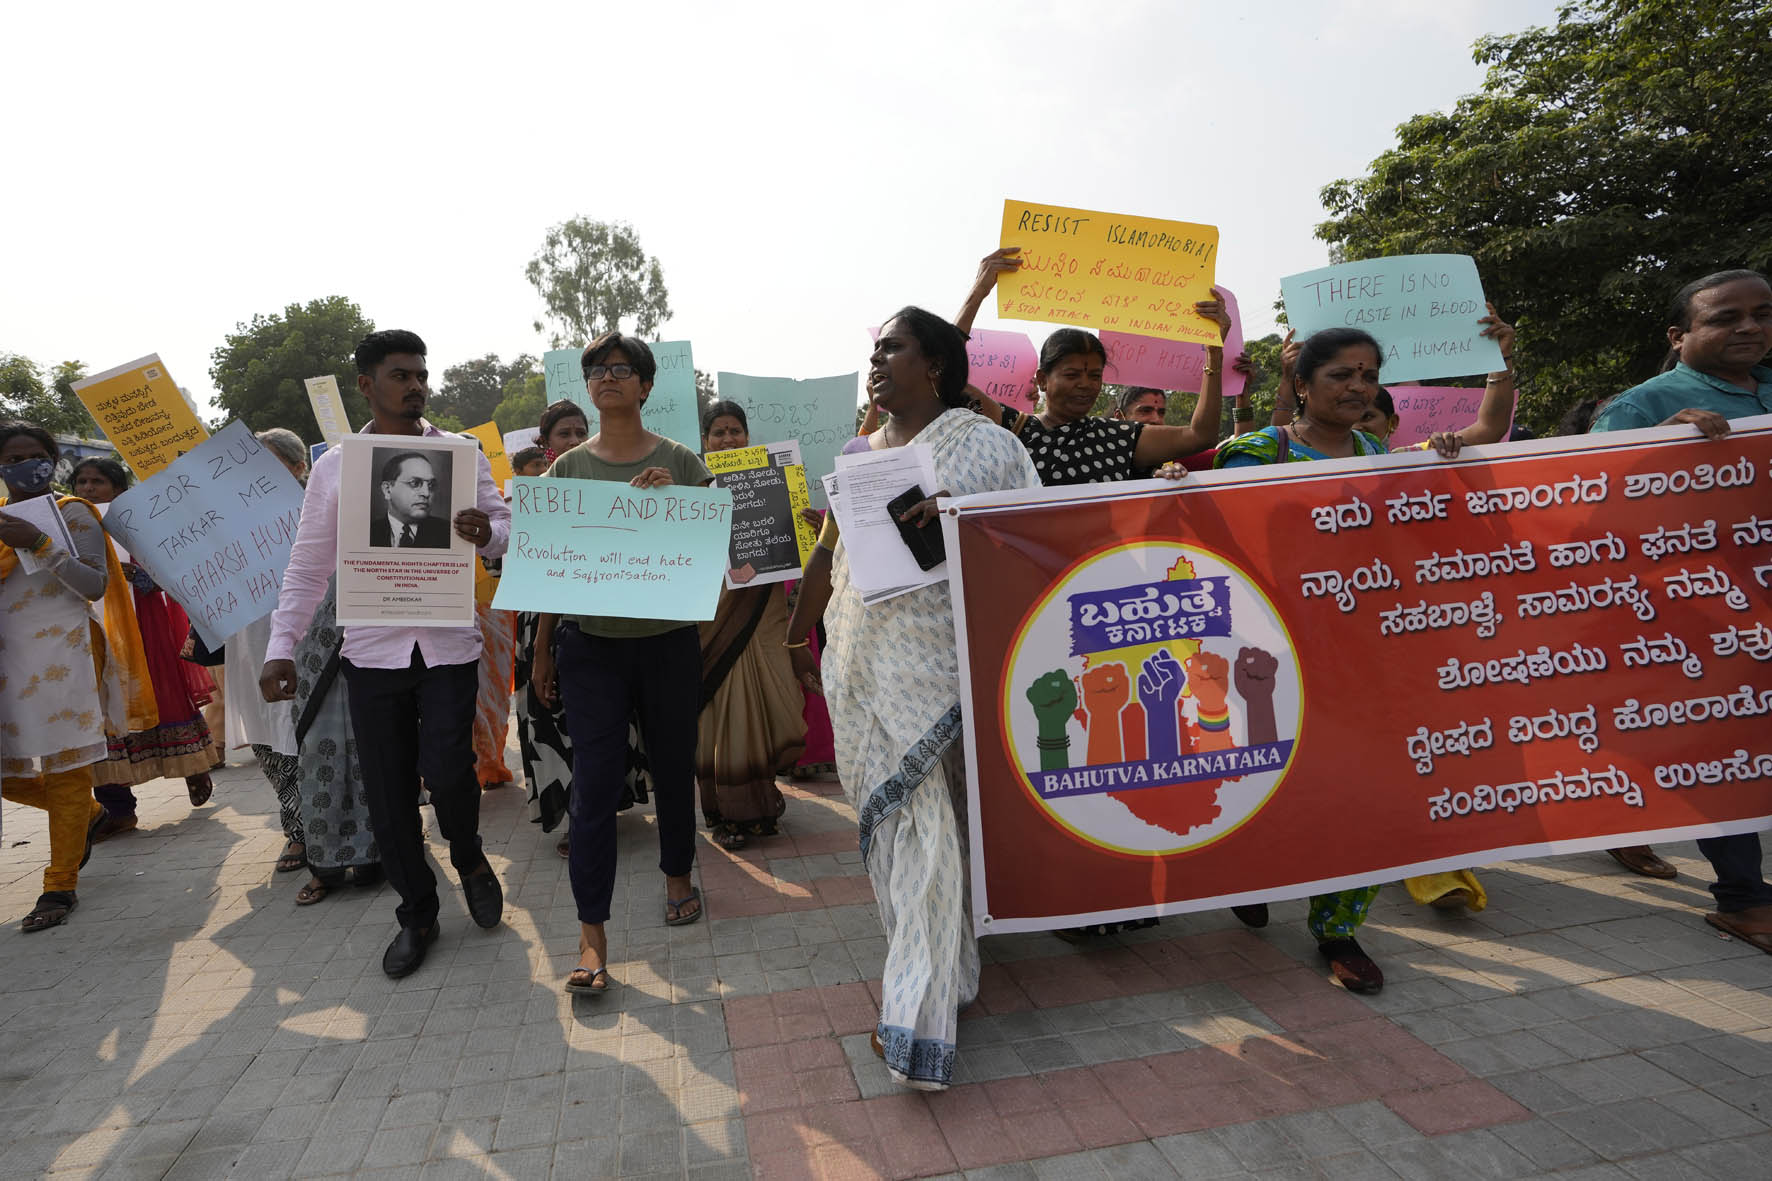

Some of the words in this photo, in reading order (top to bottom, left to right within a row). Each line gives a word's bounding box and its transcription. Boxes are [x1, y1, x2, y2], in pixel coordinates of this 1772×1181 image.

[1018, 210, 1089, 236] RESIST
[1106, 224, 1215, 269] ISLAMOPHOBIA!
[1304, 274, 1385, 307] THERE
[1400, 273, 1416, 293] IS
[1422, 272, 1450, 290] NO
[1047, 308, 1092, 321] ATTACK
[1103, 316, 1120, 325] ON
[1128, 318, 1172, 333] INDIAN
[1344, 306, 1392, 326] CASTE
[1401, 304, 1417, 320] IN
[1430, 301, 1478, 318] BLOOD
[1107, 340, 1146, 363] STOP
[1387, 345, 1400, 361] A
[1413, 337, 1473, 360] HUMAN
[985, 381, 1024, 402] CASTE!
[149, 475, 201, 520] ZOR
[208, 432, 262, 480] ZUL
[1311, 496, 1372, 533] ಇದು
[1385, 489, 1451, 523] ಸರ್ವ
[1466, 472, 1608, 514] ಜನಾಂಗದ
[1624, 456, 1755, 499] ಶಾಂತಿಯ
[158, 510, 225, 560] TAKKAR
[238, 475, 278, 507] ME
[516, 483, 586, 515] REBEL
[607, 495, 658, 520] AND
[664, 497, 732, 523] RESIST
[172, 540, 248, 604] NGHARSH
[251, 507, 302, 560] HUM
[517, 531, 587, 564] Revolution
[600, 551, 622, 566] will
[628, 553, 650, 566] end
[659, 552, 694, 567] hate
[1300, 558, 1401, 613] ನ್ಯಾಯ,
[1415, 540, 1536, 584] ಸಮಾನತೆ
[1548, 531, 1626, 567] ಹಾಗು
[1639, 519, 1718, 560] ಘನತೆ
[247, 568, 280, 604] HAI
[546, 568, 565, 579] and
[1080, 581, 1223, 627] ಬಹುತ್ವ
[1379, 591, 1503, 638] ಸಹಬಾಳ್ವೆ,
[1517, 574, 1656, 621] ಸಾಮರಸ್ಯ
[1663, 564, 1750, 610] ನಮ್ಮ
[1105, 615, 1206, 643] ಕರ್ನಾಟಕ
[1437, 642, 1607, 690] ಶೋಷಣೆಯು
[1620, 632, 1703, 678] ನಮ್ಮ
[1406, 717, 1494, 775] ದ್ವೇಷದ
[1508, 704, 1600, 754] ವಿರುದ್ಧ
[1043, 764, 1148, 793] BAHUTVA
[1153, 747, 1281, 780] KARNATAKA
[1428, 764, 1644, 820] ಸಂವಿಧಾನವನ್ನು
